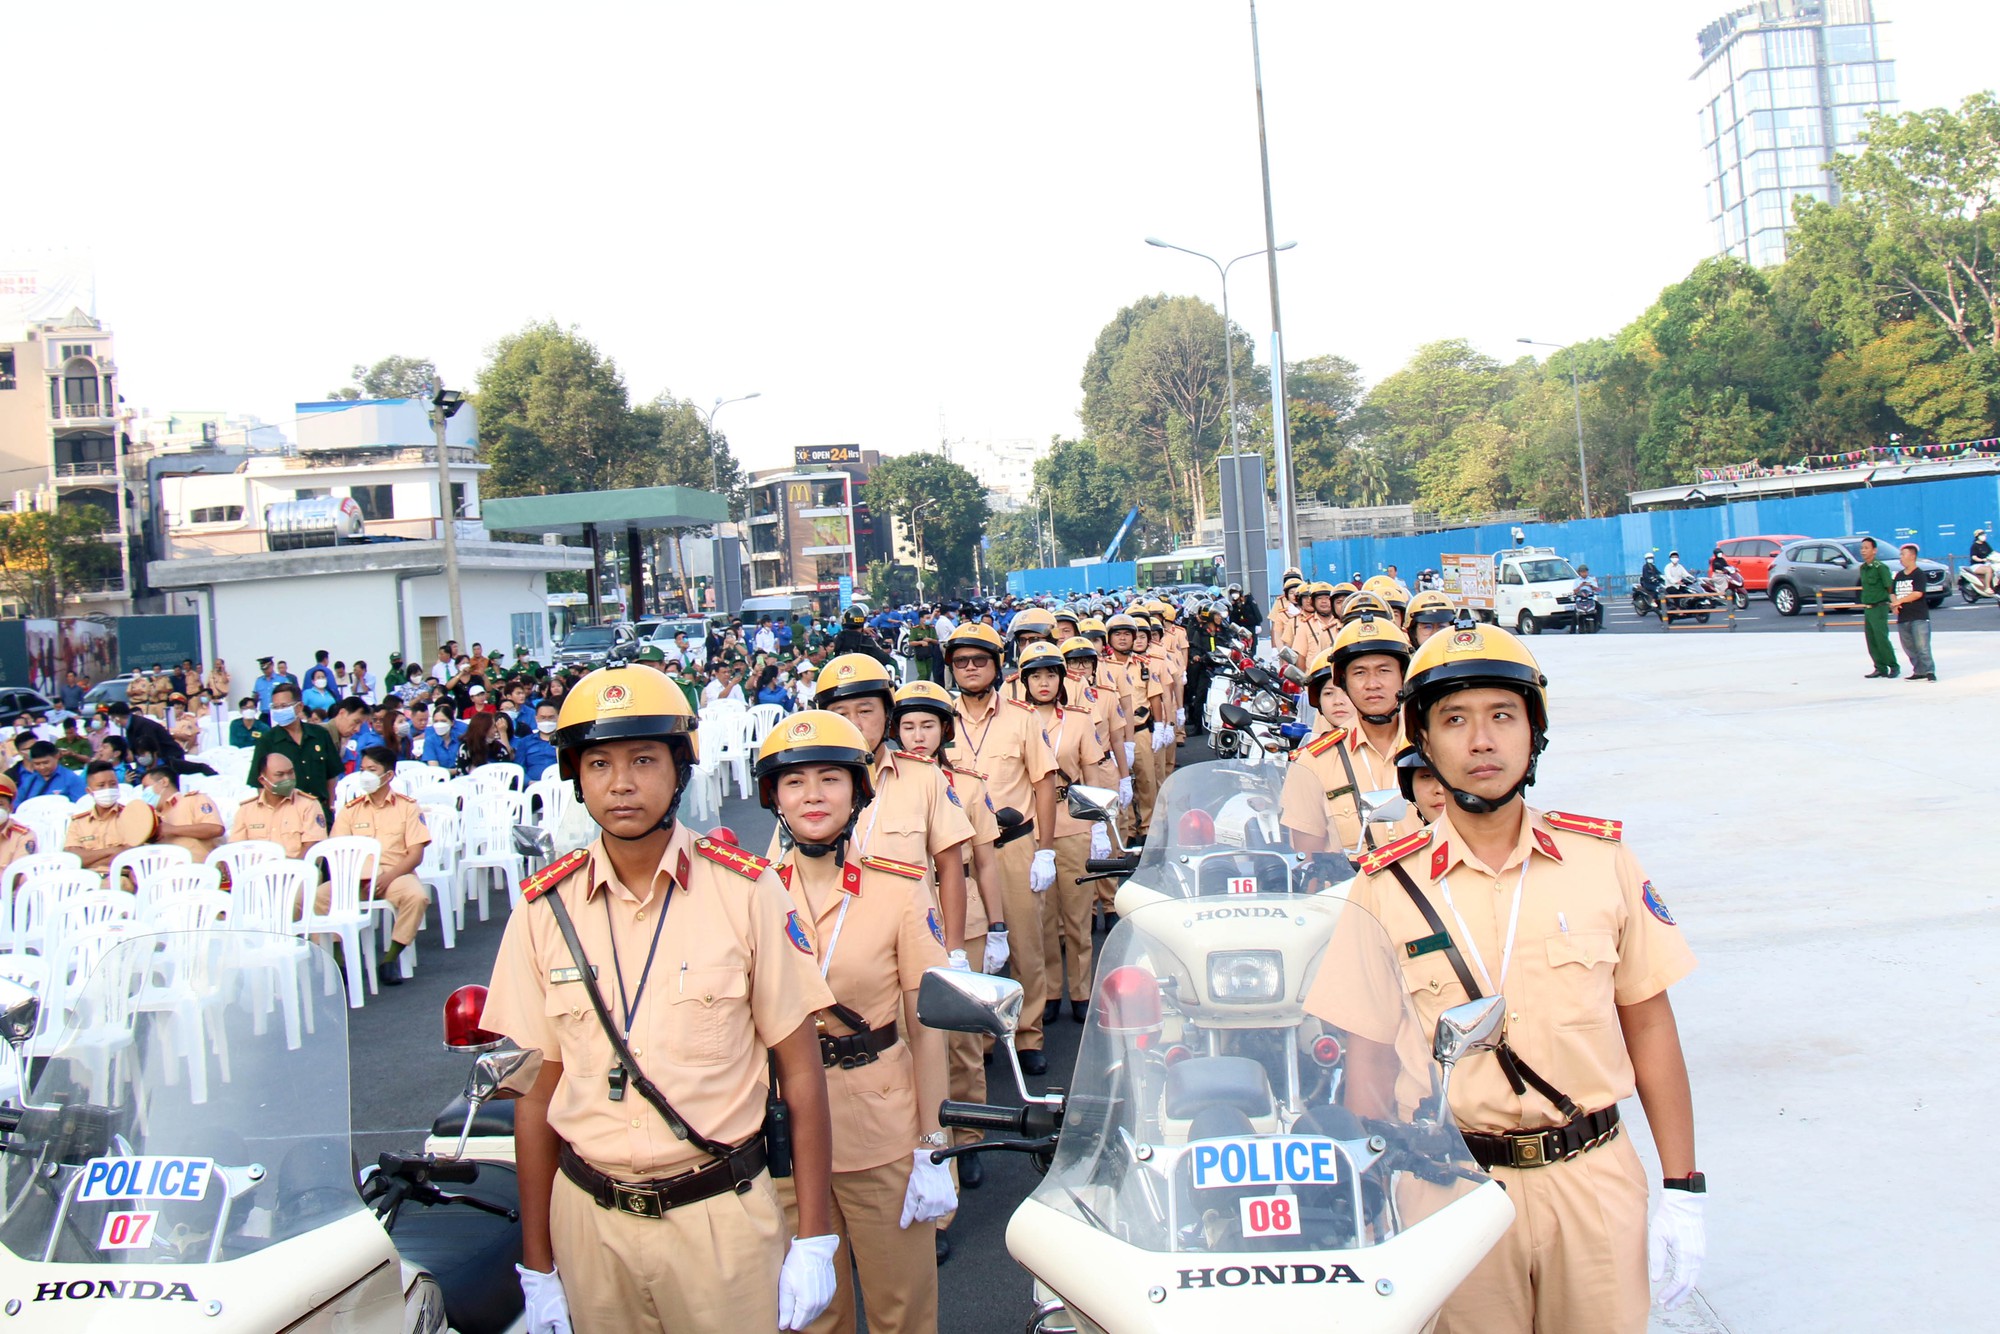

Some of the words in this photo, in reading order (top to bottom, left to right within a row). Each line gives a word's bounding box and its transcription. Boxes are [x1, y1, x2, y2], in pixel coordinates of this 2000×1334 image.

[812, 451, 830, 460] OPEN
[830, 447, 848, 461] 24
[848, 450, 859, 458] Hrs
[1231, 878, 1254, 893] 16
[1195, 907, 1289, 921] HONDA
[1196, 1141, 1335, 1185] POLICE
[83, 1160, 207, 1197] POLICE
[1249, 1199, 1292, 1232] 08
[109, 1214, 151, 1245] 07
[1177, 1264, 1364, 1290] HONDA
[33, 1280, 198, 1302] HONDA
